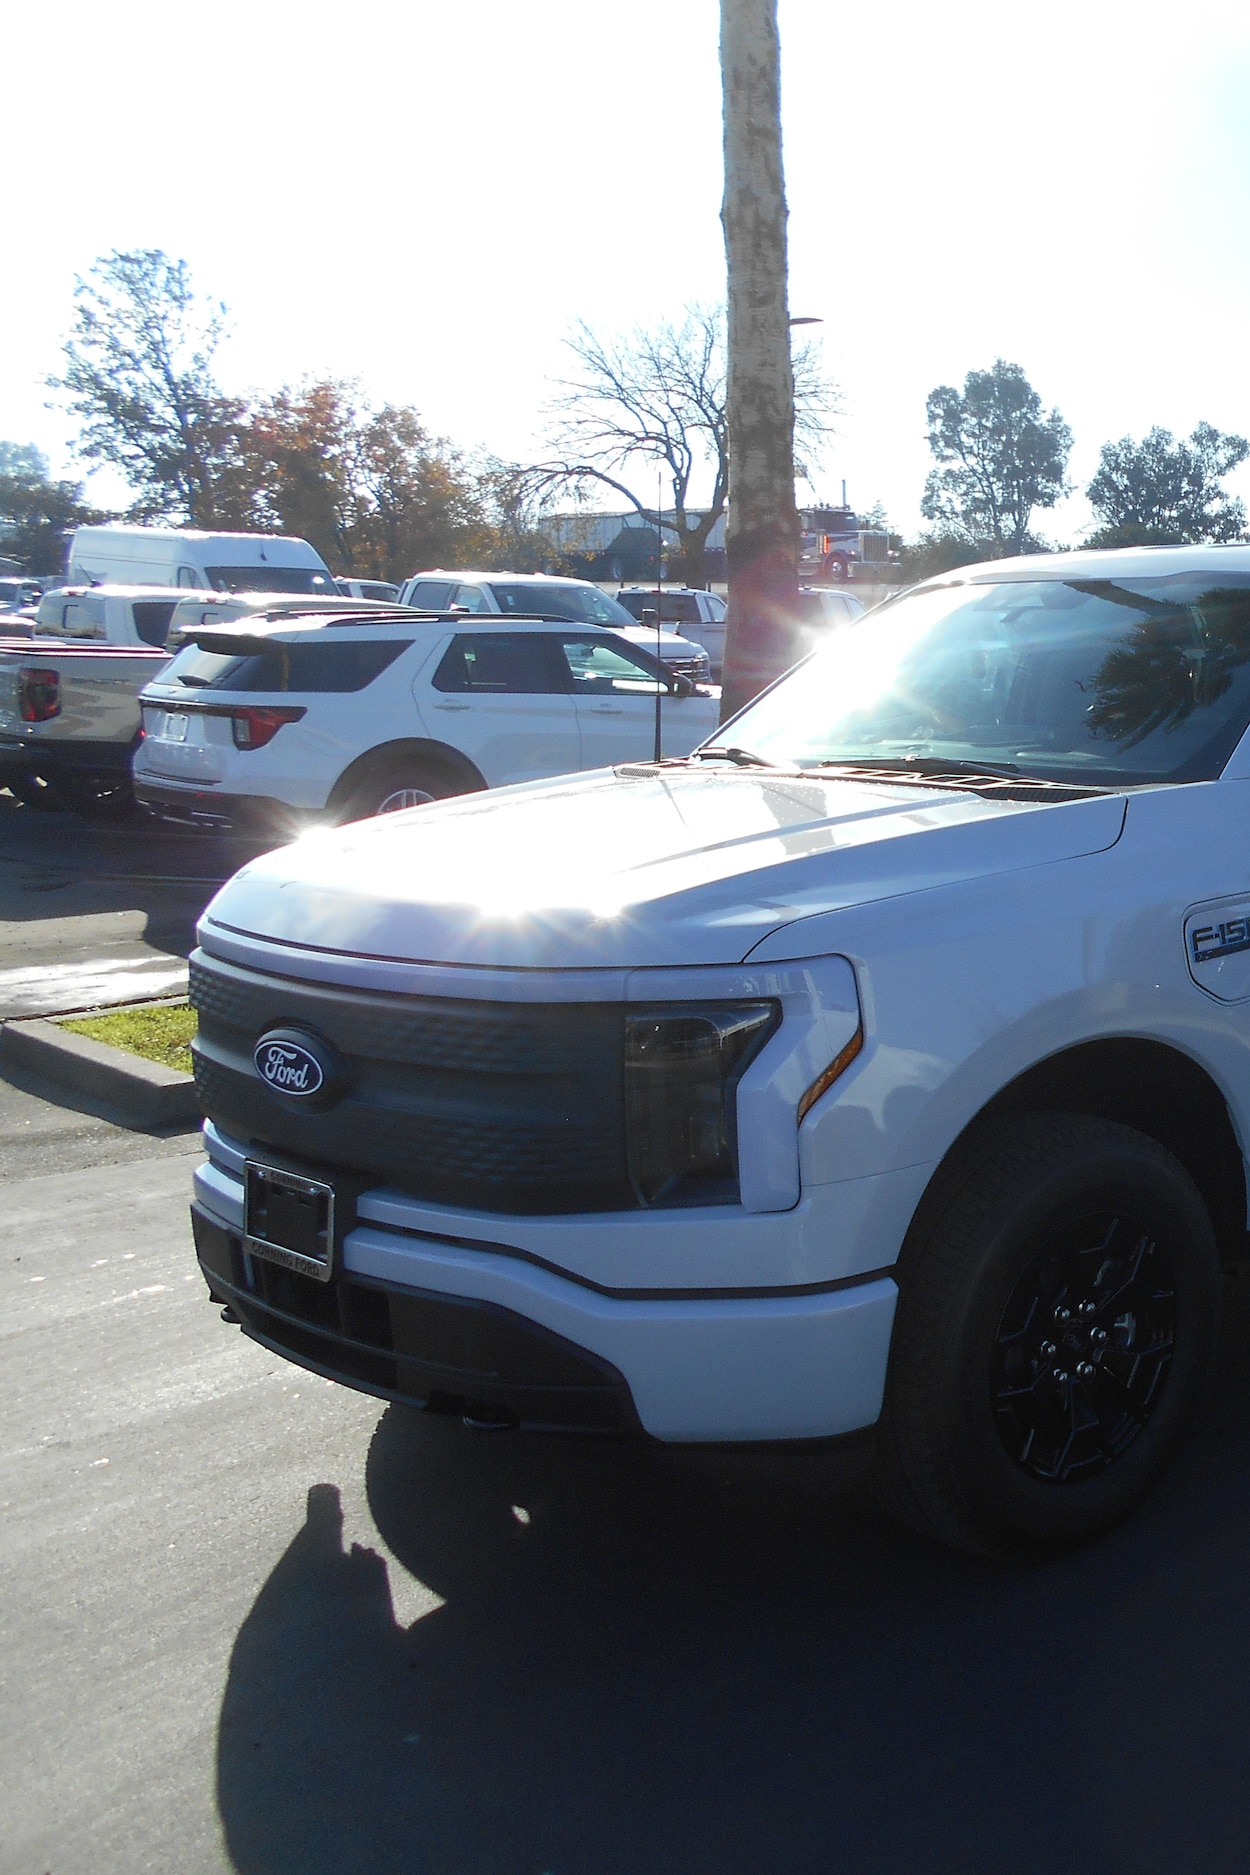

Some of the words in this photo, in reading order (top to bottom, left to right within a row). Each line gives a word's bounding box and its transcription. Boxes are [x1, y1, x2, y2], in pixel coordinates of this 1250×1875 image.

[265, 1046, 309, 1088] Ford
[252, 1241, 293, 1263] CORNING
[295, 1256, 319, 1276] FORD
